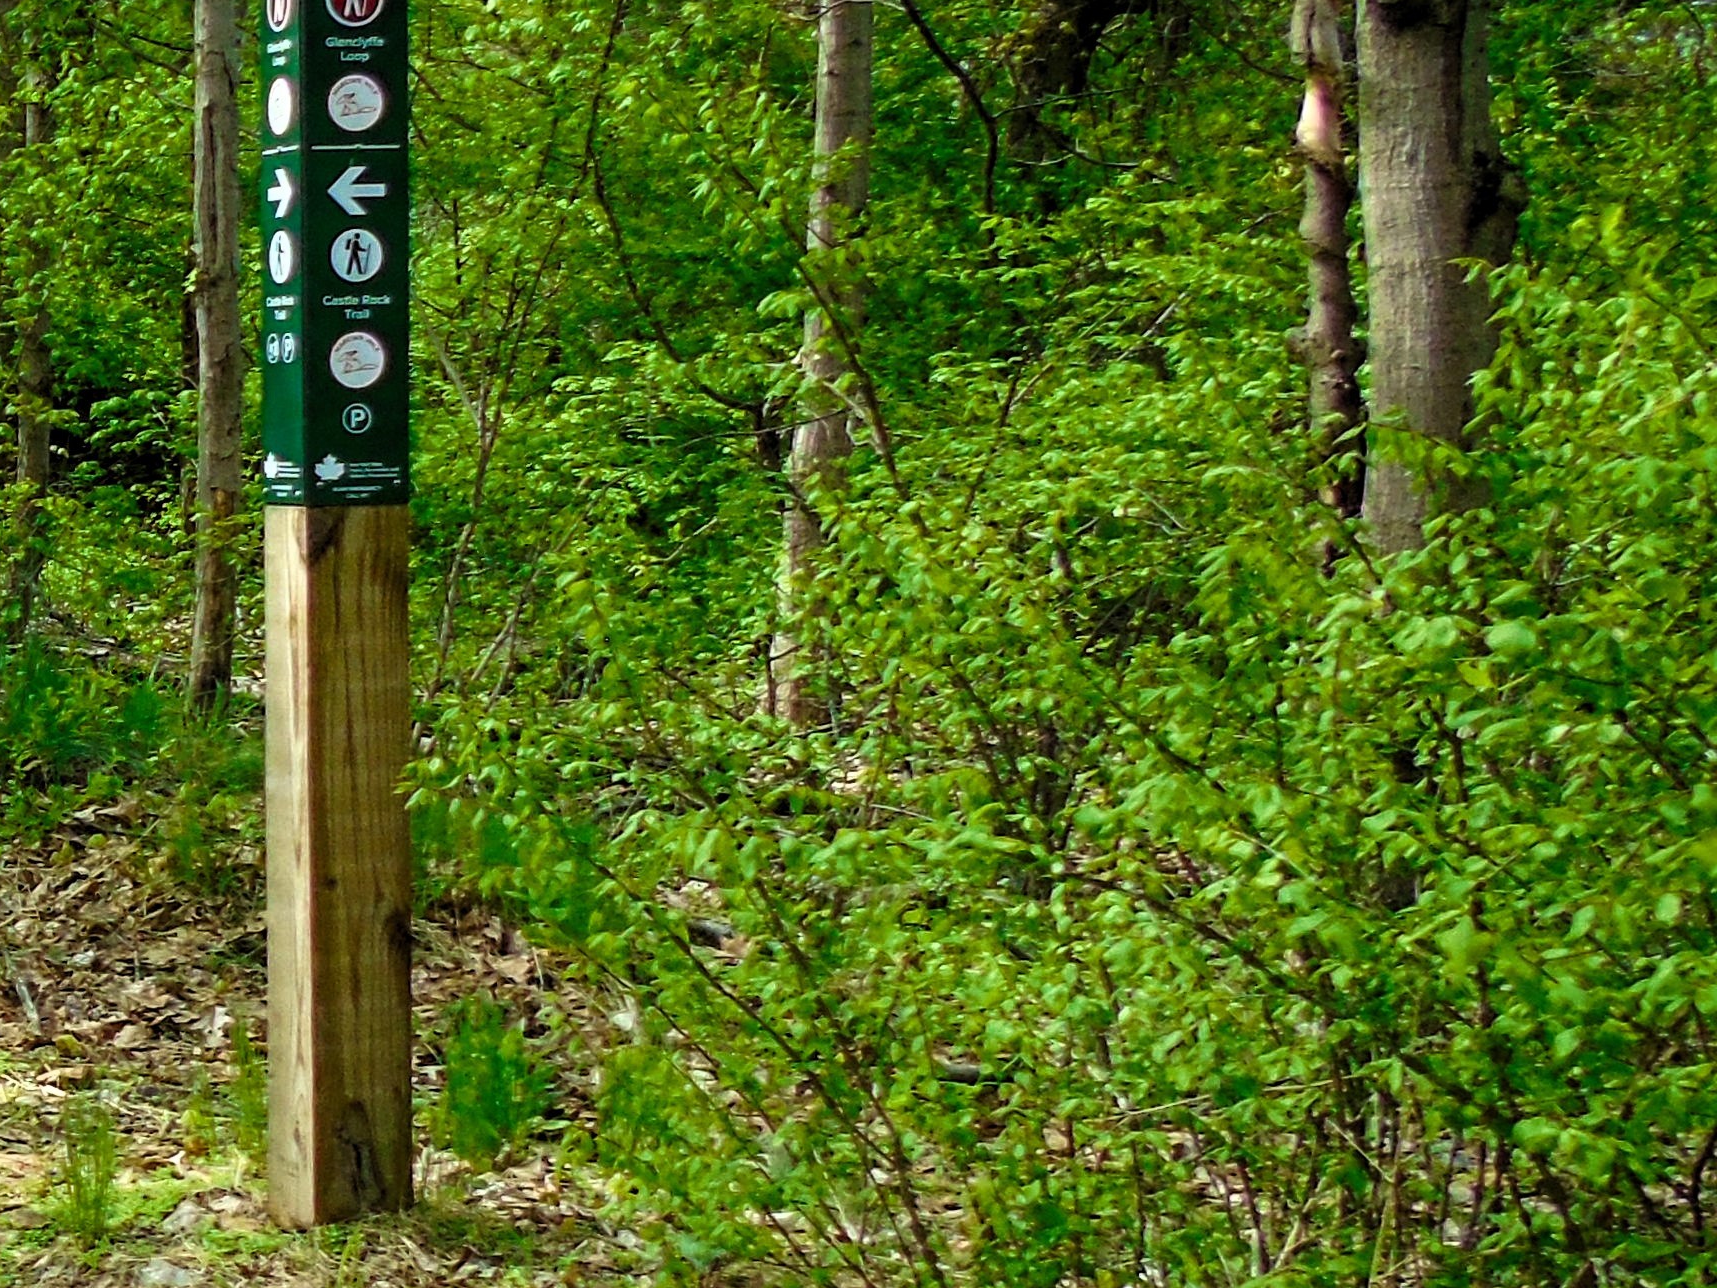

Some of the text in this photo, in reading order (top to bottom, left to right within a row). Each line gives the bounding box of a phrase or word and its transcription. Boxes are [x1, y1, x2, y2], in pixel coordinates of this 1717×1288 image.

[340, 51, 370, 63] Loop
[322, 295, 391, 305] Castle Rock
[344, 308, 370, 319] Trail
